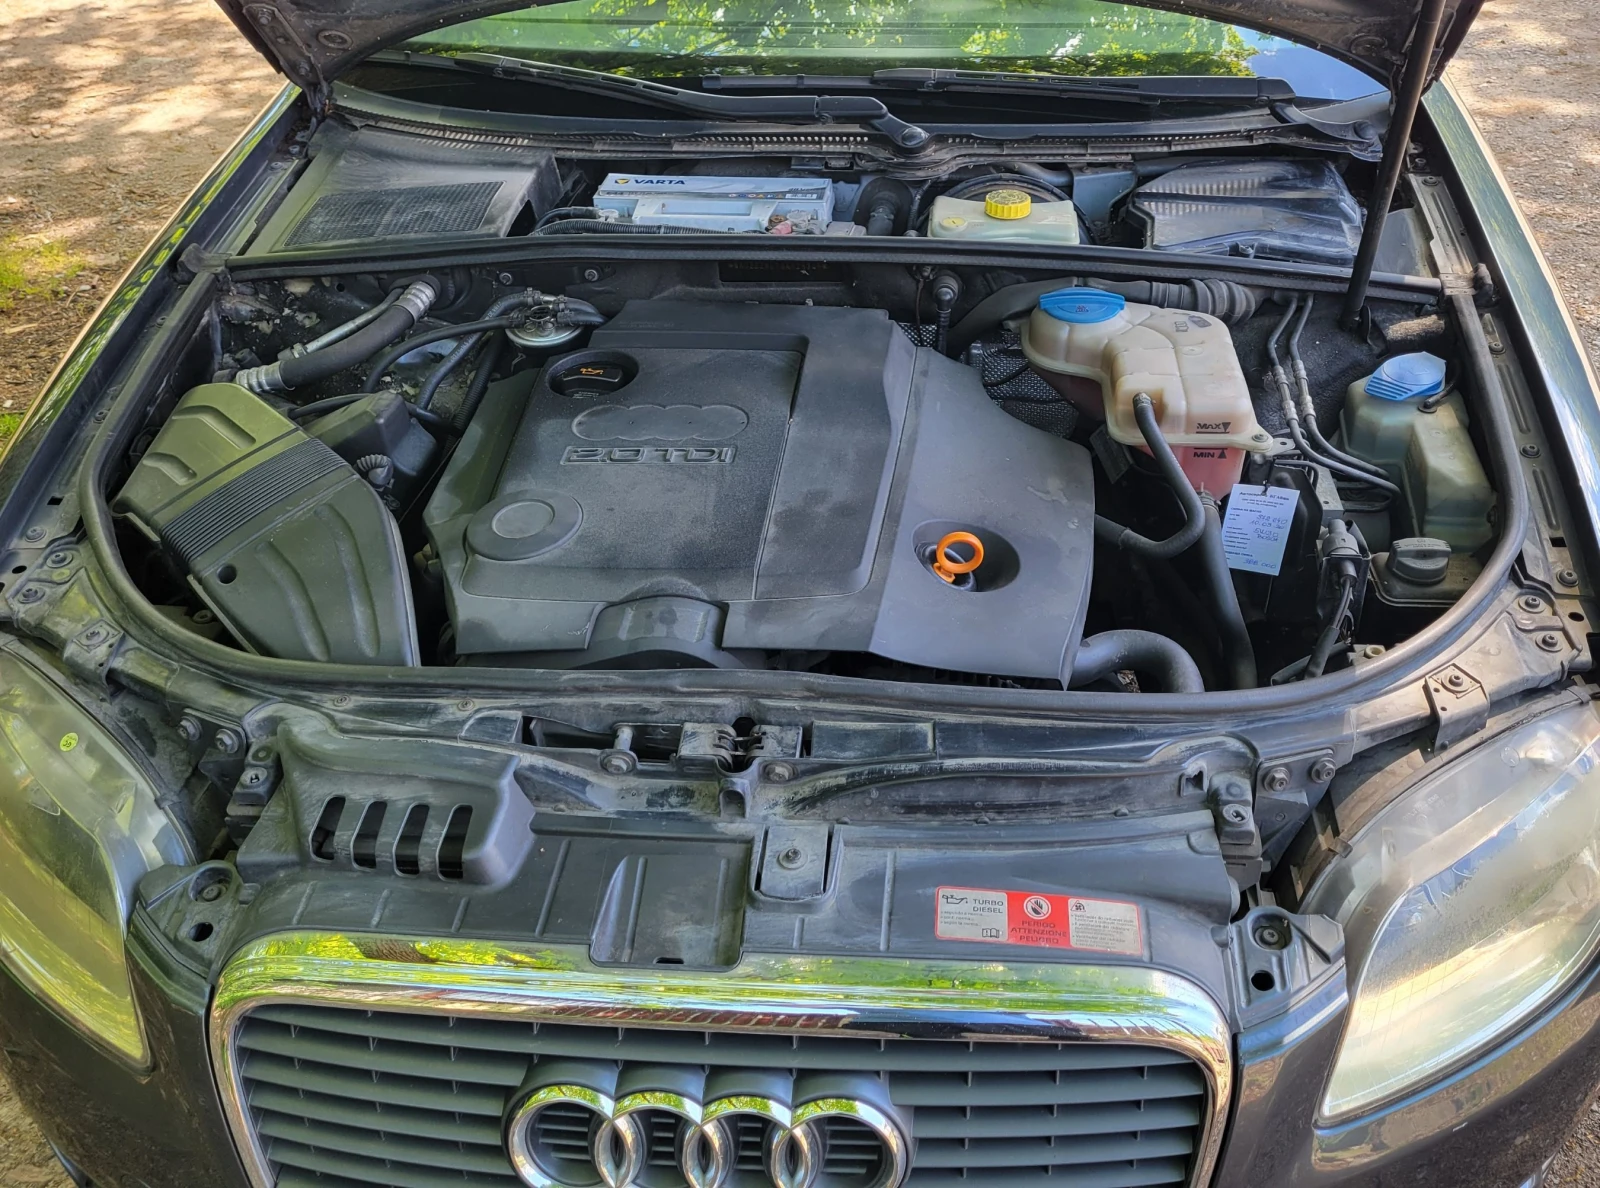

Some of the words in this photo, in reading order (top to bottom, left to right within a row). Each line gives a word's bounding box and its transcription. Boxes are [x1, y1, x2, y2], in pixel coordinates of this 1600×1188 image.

[1196, 422, 1221, 430] MAX
[654, 448, 734, 462] TDI
[972, 898, 1004, 907] TURBO
[972, 906, 1003, 914] DIESEL
[1021, 920, 1056, 929] PERIGO
[1010, 927, 1067, 937] ATTENZIONE
[1019, 935, 1059, 944] PELIGRO
